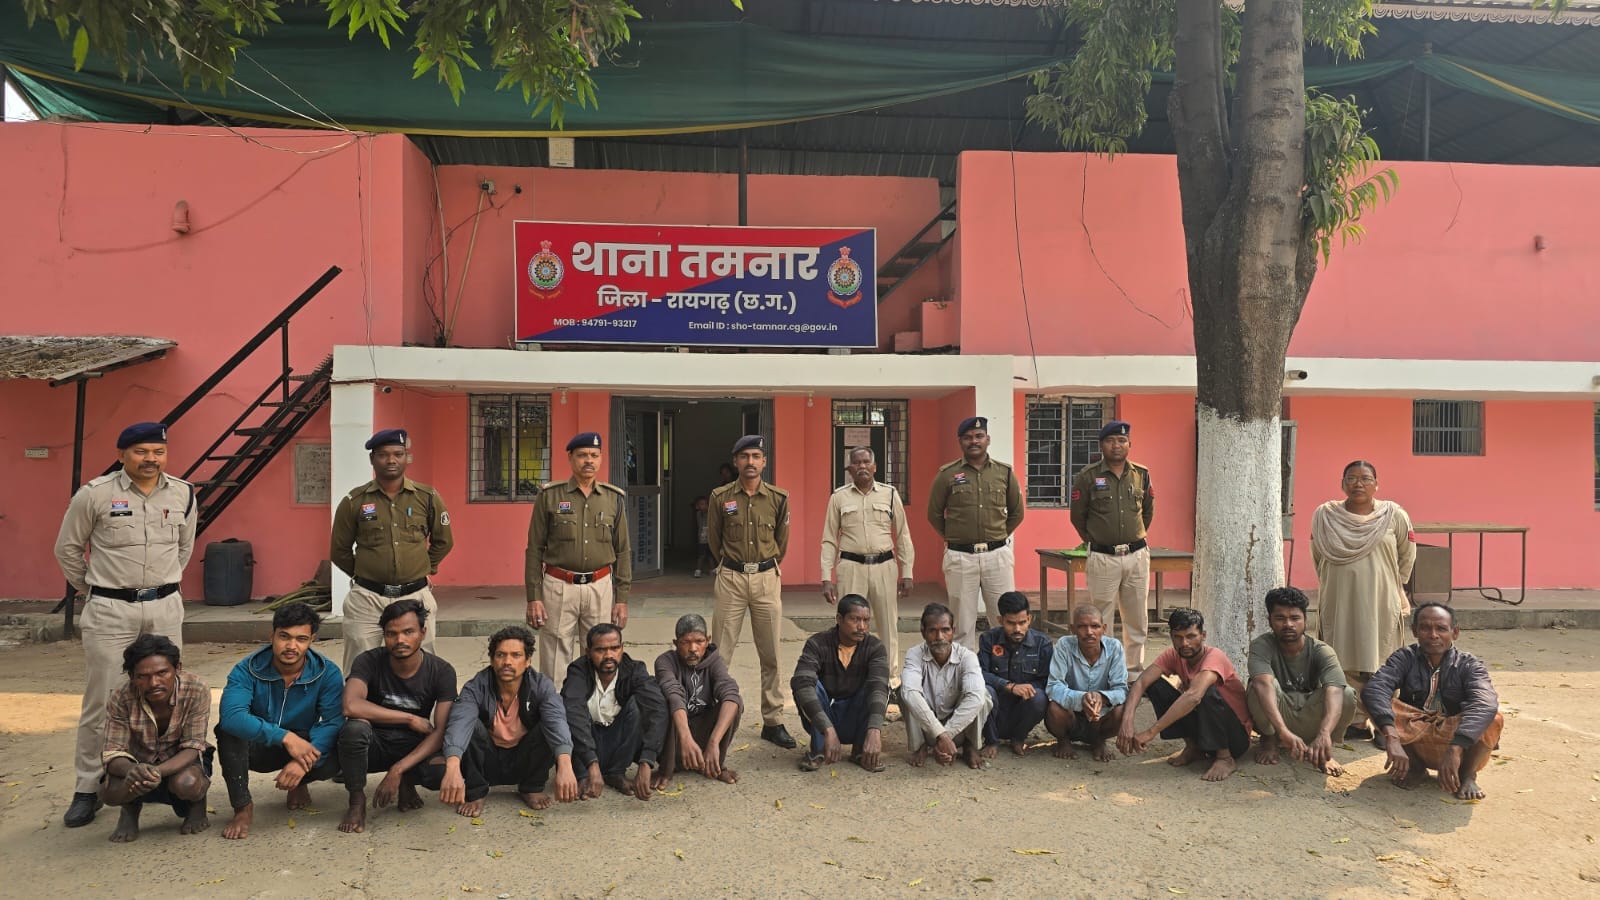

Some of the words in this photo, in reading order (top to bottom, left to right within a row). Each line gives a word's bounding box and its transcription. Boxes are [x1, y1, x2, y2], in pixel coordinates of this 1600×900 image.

[572, 241, 671, 277] थाना
[678, 244, 820, 280] तमनार
[597, 285, 648, 308] जिला
[666, 292, 730, 314] रायगढ़
[734, 291, 797, 314] (छ.ग.)
[553, 318, 576, 326] MOB
[581, 318, 637, 328] 94791-93217
[688, 321, 715, 330] Email
[731, 321, 838, 333] sho-tamnar.cg@gov.in
